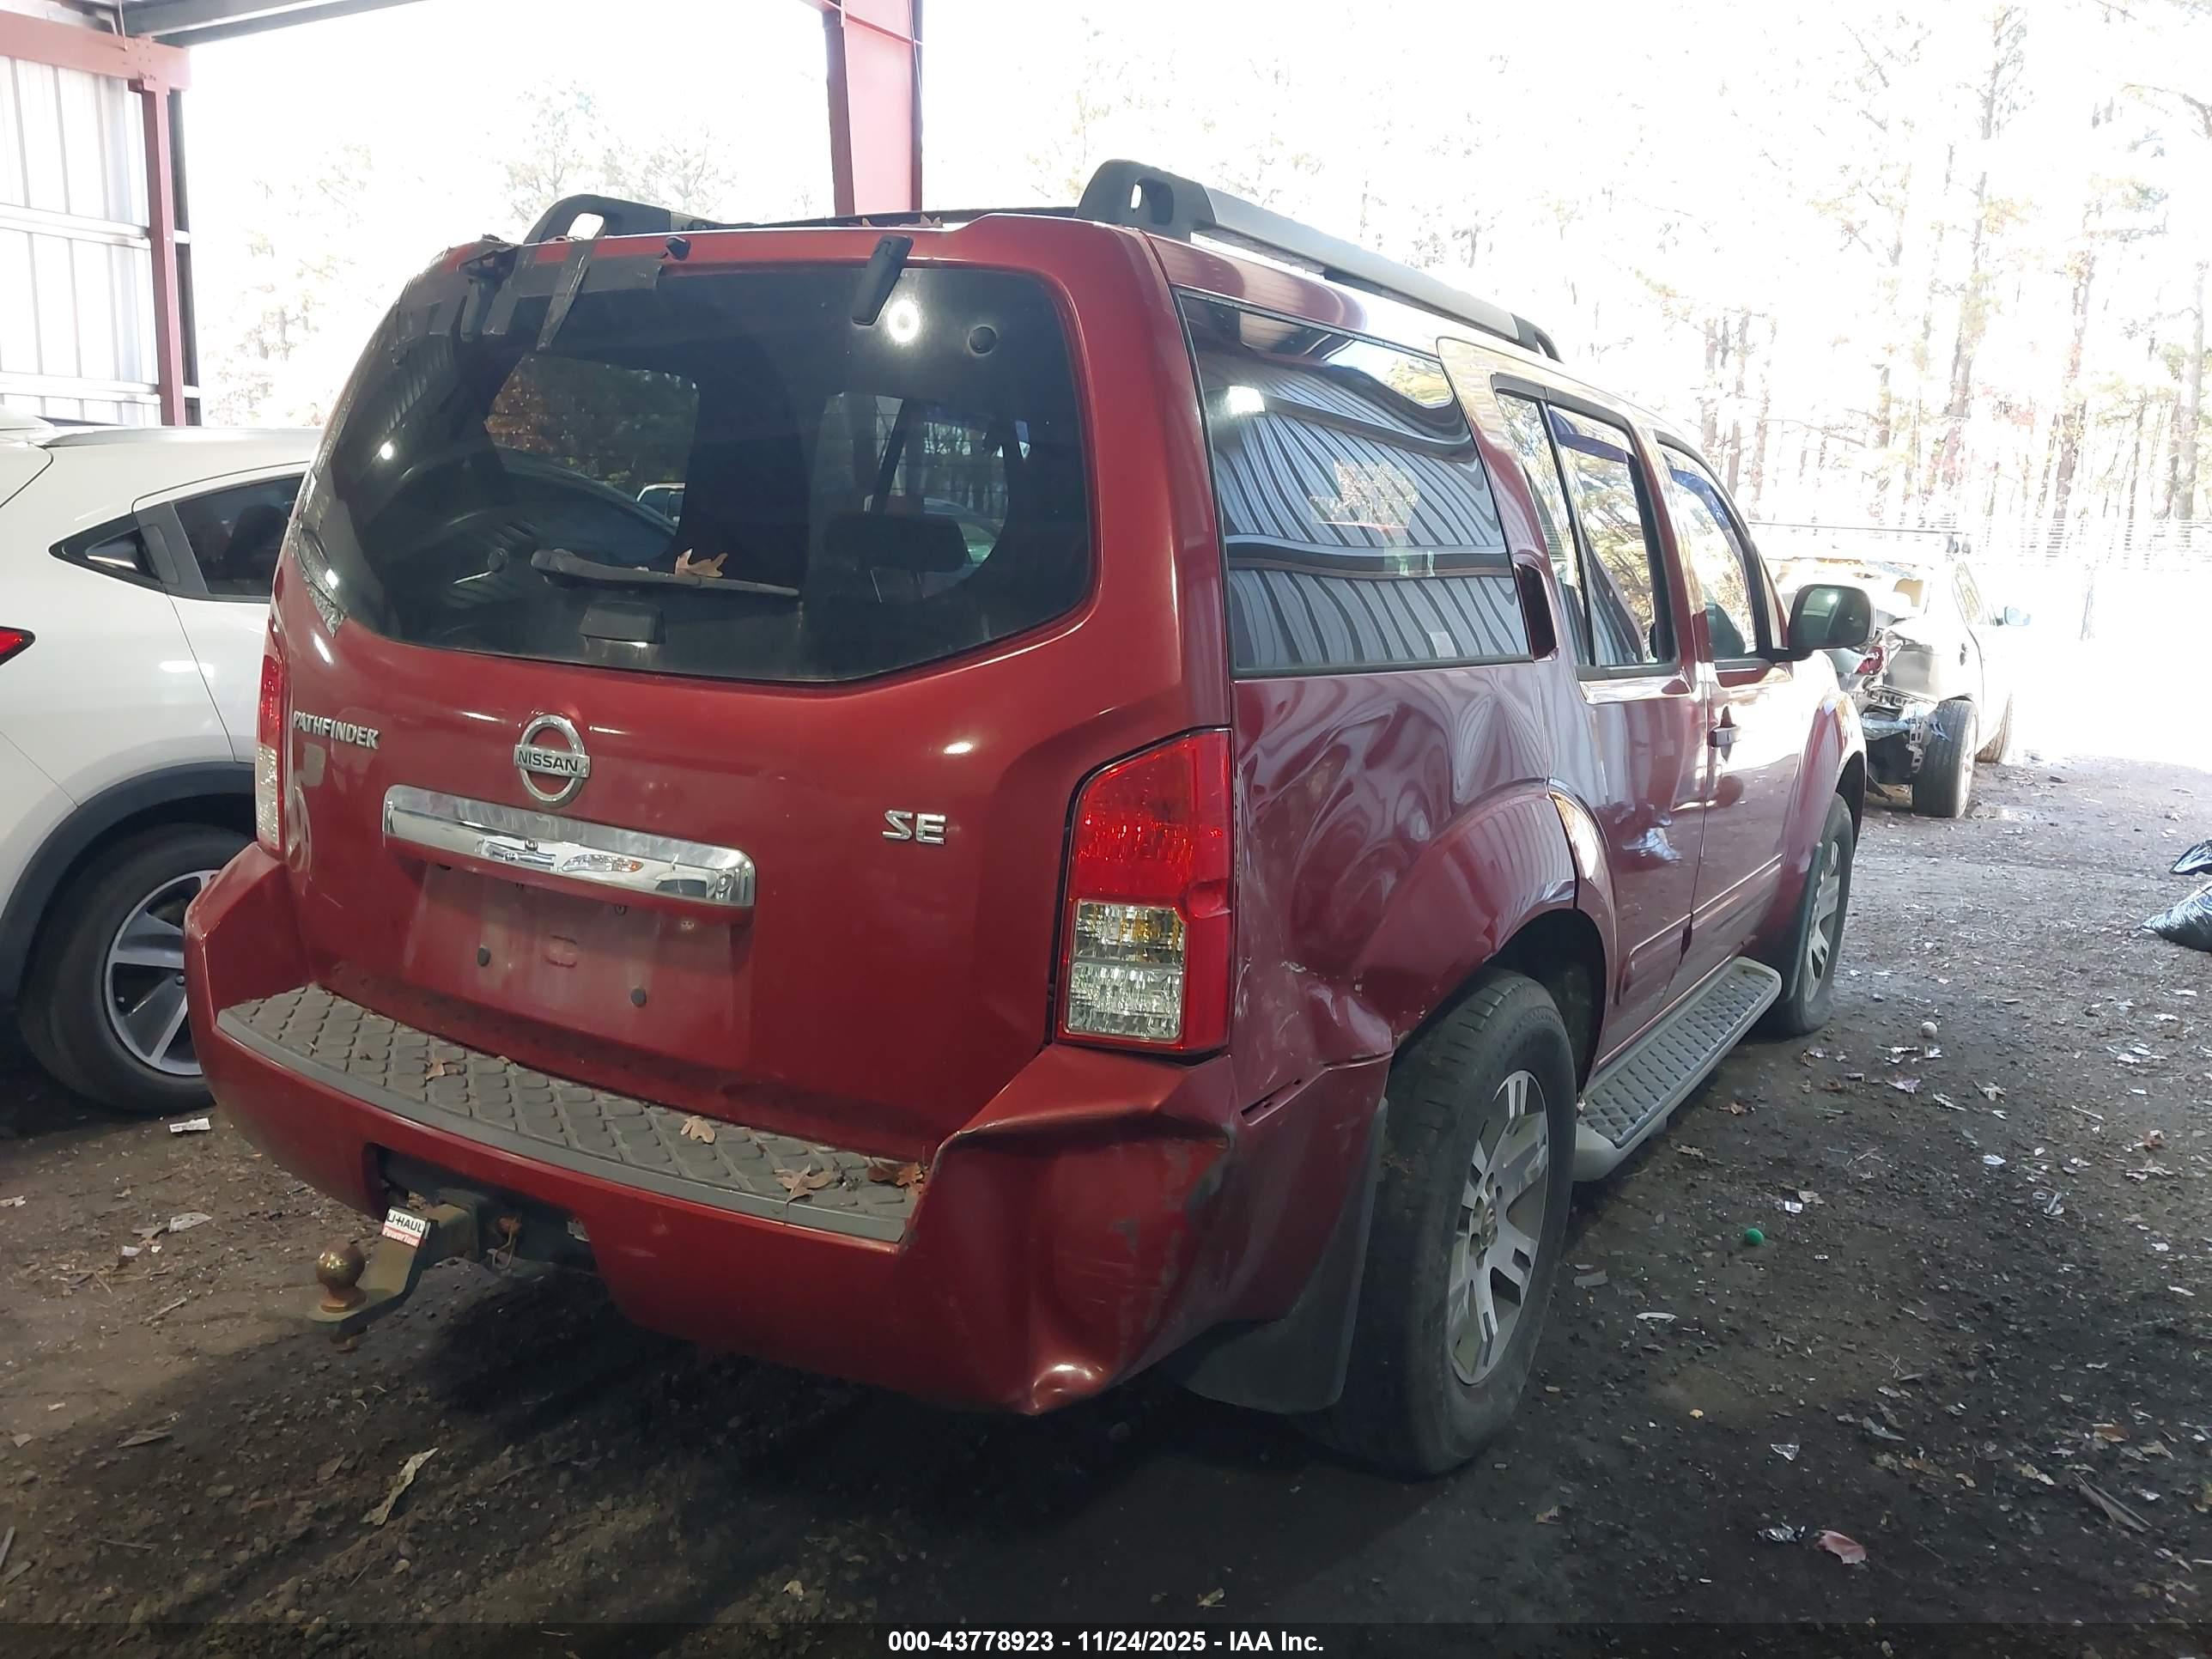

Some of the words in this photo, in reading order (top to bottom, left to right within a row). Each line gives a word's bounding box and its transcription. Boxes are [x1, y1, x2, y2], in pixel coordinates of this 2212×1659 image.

[293, 710, 379, 749] PATHFINDER
[518, 750, 578, 772] NISSAN
[882, 810, 945, 845] SE
[386, 1212, 422, 1233] U-HAUL
